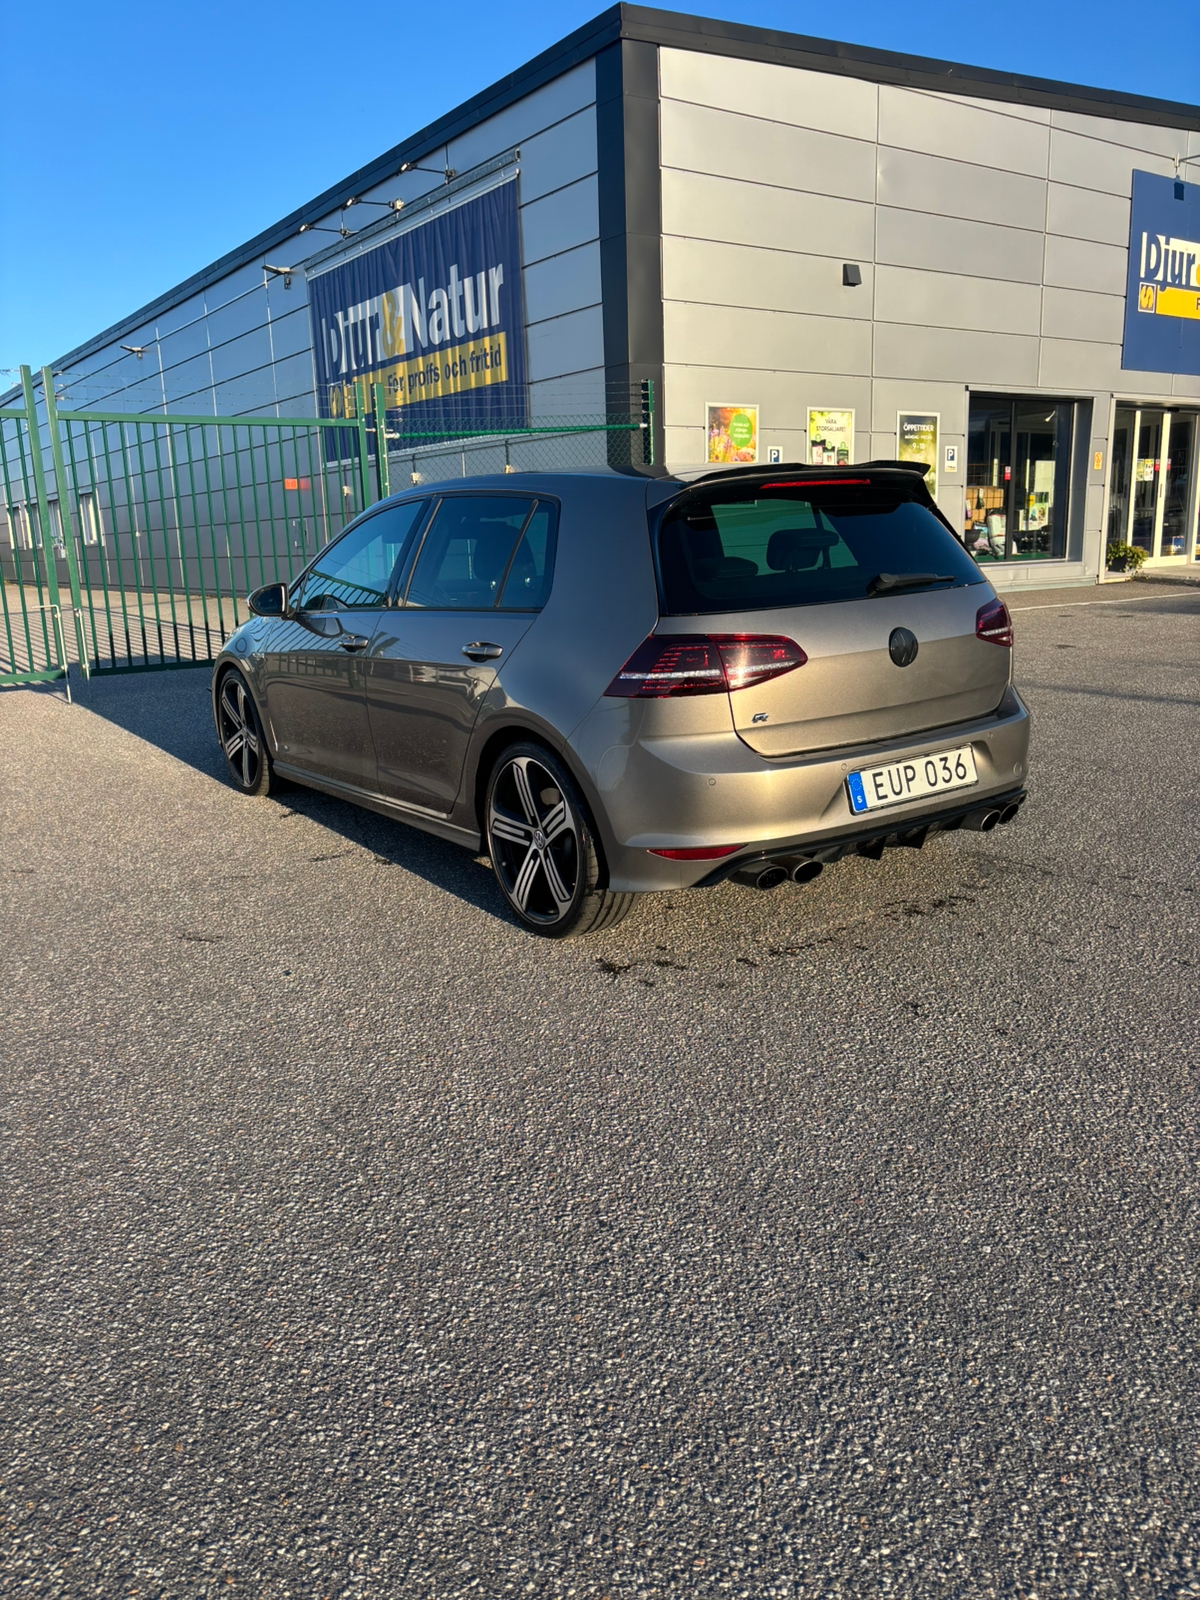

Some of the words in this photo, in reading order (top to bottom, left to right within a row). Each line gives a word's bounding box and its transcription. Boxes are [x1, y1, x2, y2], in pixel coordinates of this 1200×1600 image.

[1140, 231, 1200, 288] Djur
[387, 371, 404, 395] För
[408, 362, 440, 395] proffs
[444, 355, 467, 379] och
[469, 344, 502, 375] fritid
[903, 422, 934, 432] ÖPPETTIDER
[947, 449, 954, 460] P
[872, 765, 916, 801] EUP
[924, 753, 967, 787] 036
[857, 795, 863, 804] S
